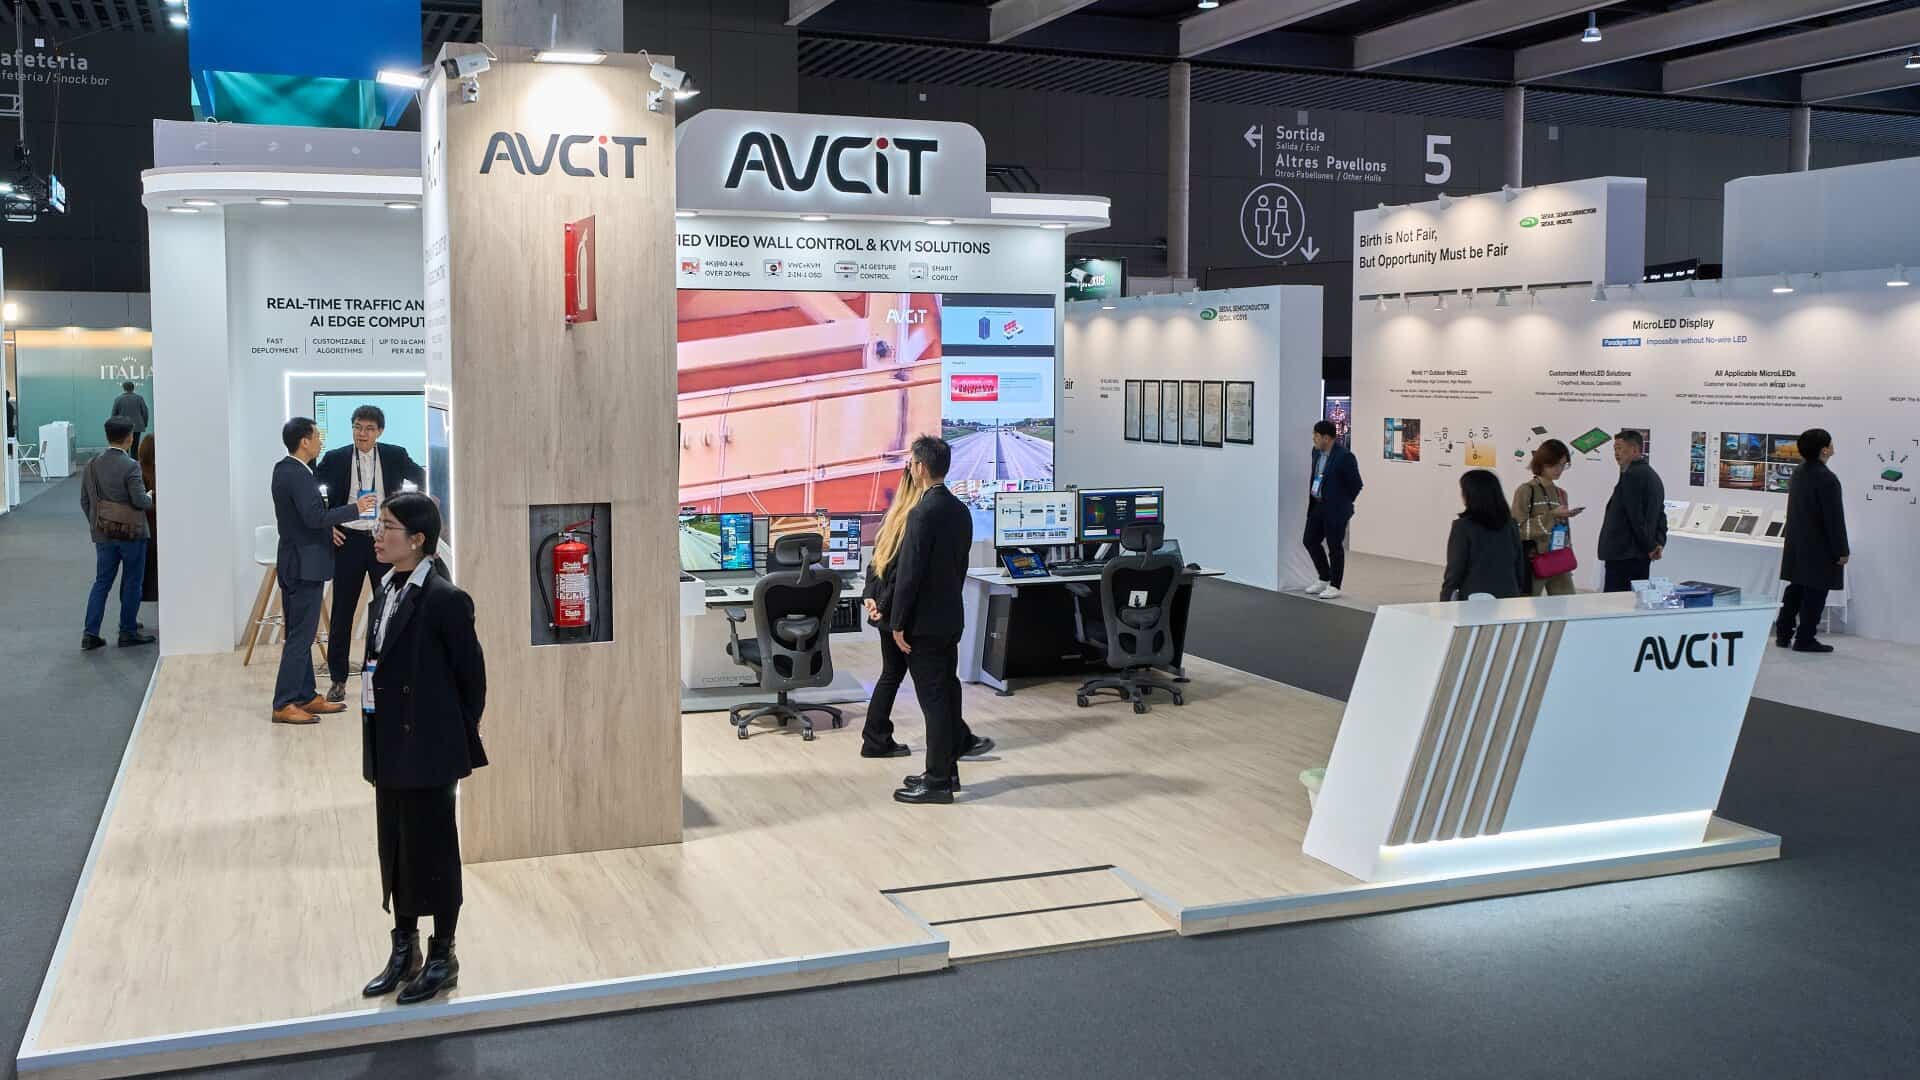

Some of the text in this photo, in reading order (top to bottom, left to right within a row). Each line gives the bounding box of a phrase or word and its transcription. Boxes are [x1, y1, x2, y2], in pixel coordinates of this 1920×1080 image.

[90, 74, 109, 86] bar
[1276, 125, 1325, 142] Sortida
[1276, 142, 1298, 151] Salida
[1305, 143, 1320, 152] Exit
[1275, 153, 1388, 172] Altres Pavellons
[1425, 134, 1452, 185] 5
[1275, 169, 1295, 178] Otros
[1343, 173, 1362, 181] Other
[1364, 174, 1382, 183] Halls
[704, 235, 750, 248] VIDEO
[753, 236, 793, 249] WALL
[796, 237, 863, 251] CONTROL
[866, 239, 877, 251] &
[880, 240, 912, 252] KVM
[915, 241, 991, 255] SOLUTIONS
[1360, 228, 1438, 248] Birth is Not Fair,
[1360, 243, 1509, 269] But Opportunity Must be Fair
[734, 271, 751, 279] Mbps
[267, 297, 425, 311] REAL-TIME TRAFFIC AN
[310, 315, 324, 327] AI
[328, 316, 366, 328] EDGE
[1632, 317, 1715, 331] MicroLED Display
[1646, 337, 1679, 346] Impossible
[1680, 336, 1704, 345] without
[1732, 335, 1748, 343] LED
[1724, 370, 1757, 378] Applicable
[1758, 369, 1796, 377] MicroLEDs
